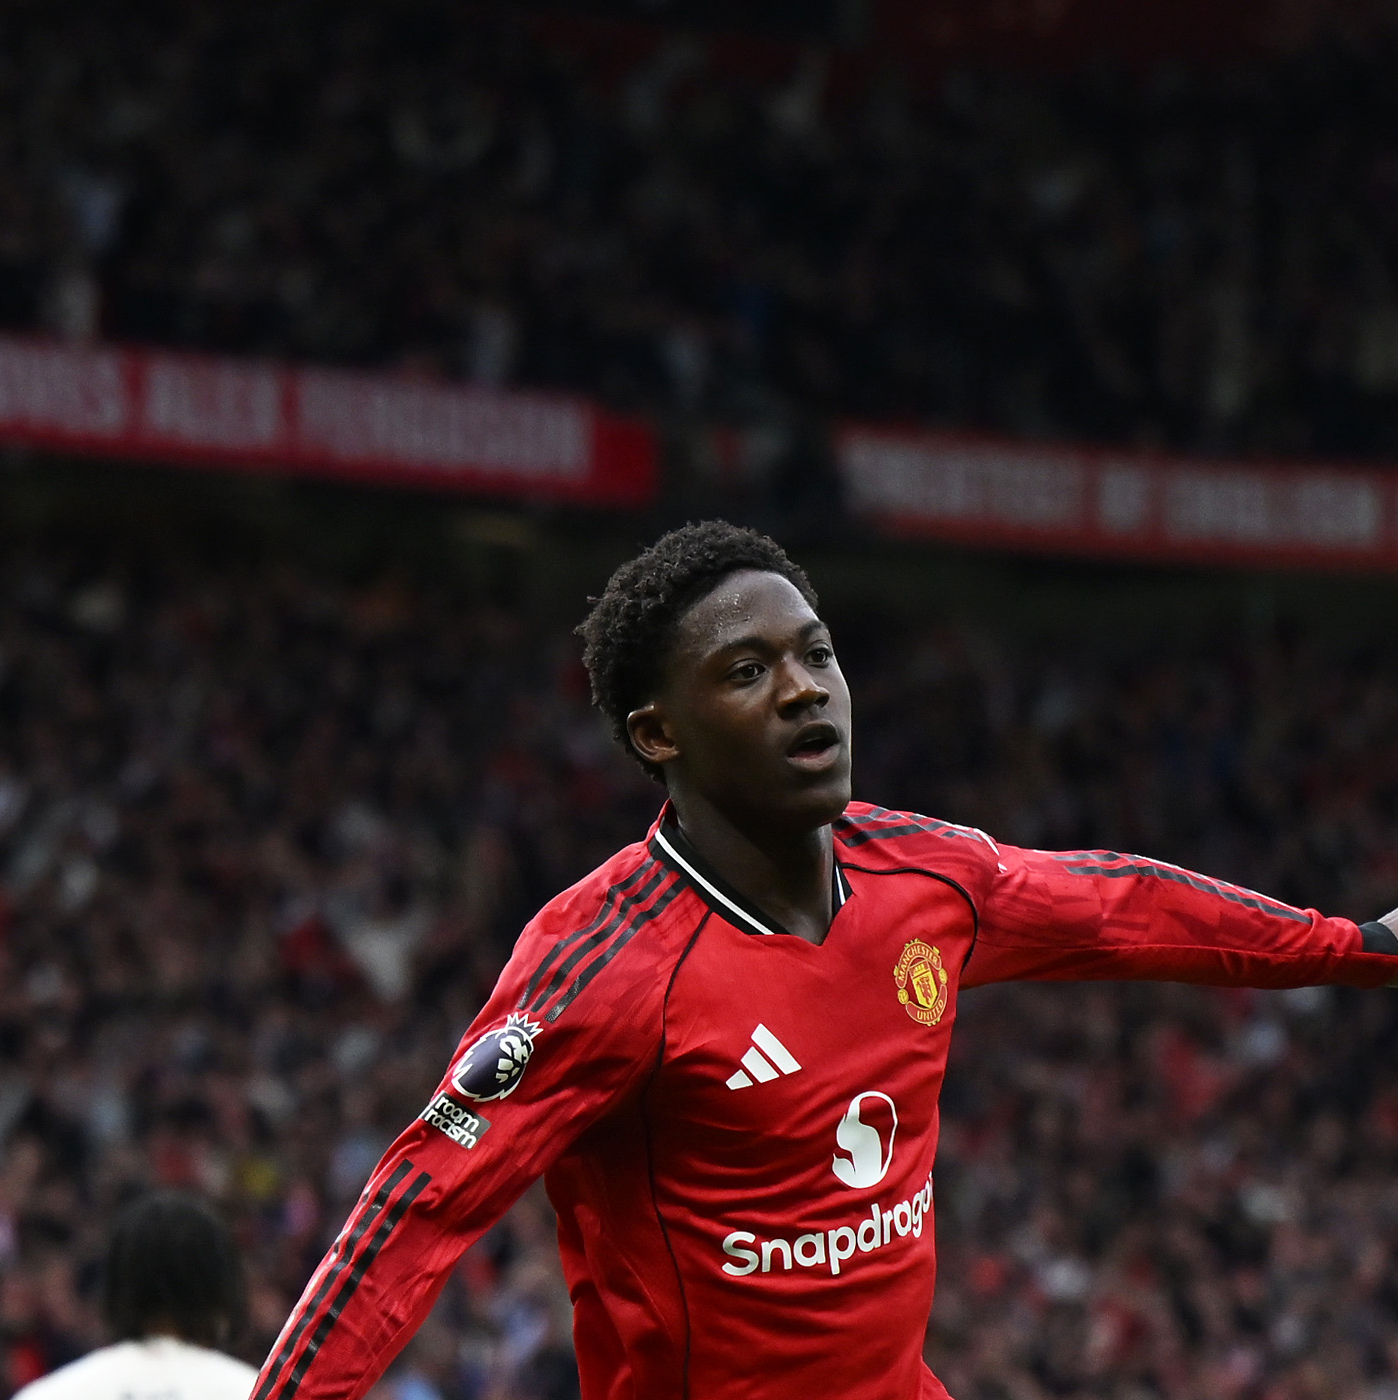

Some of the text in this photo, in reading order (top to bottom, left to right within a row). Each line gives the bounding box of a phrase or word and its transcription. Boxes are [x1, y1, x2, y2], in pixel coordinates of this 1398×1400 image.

[898, 944, 939, 981] MANCHESTER
[916, 999, 944, 1020] UNITED
[423, 1108, 477, 1150] racism
[434, 1096, 480, 1133] room
[721, 1171, 934, 1277] Snapdrago
